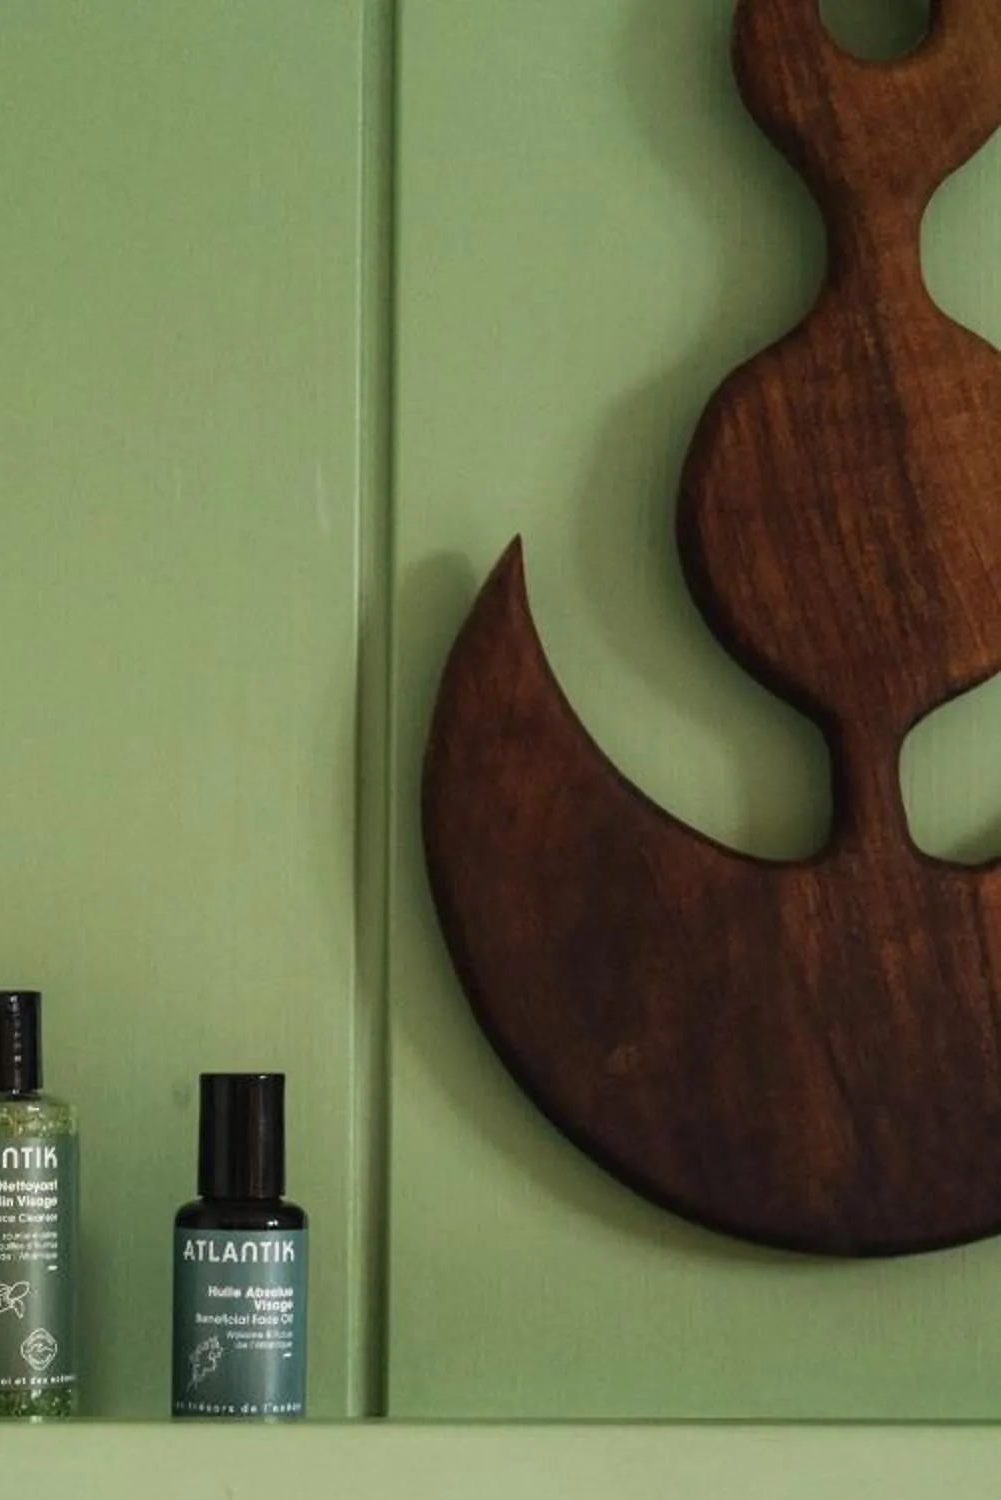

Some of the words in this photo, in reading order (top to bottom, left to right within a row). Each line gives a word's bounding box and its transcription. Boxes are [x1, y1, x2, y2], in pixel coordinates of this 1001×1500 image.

[18, 1195, 58, 1209] Visage
[183, 1239, 295, 1263] ATLANTIK
[254, 1299, 293, 1312] Visage
